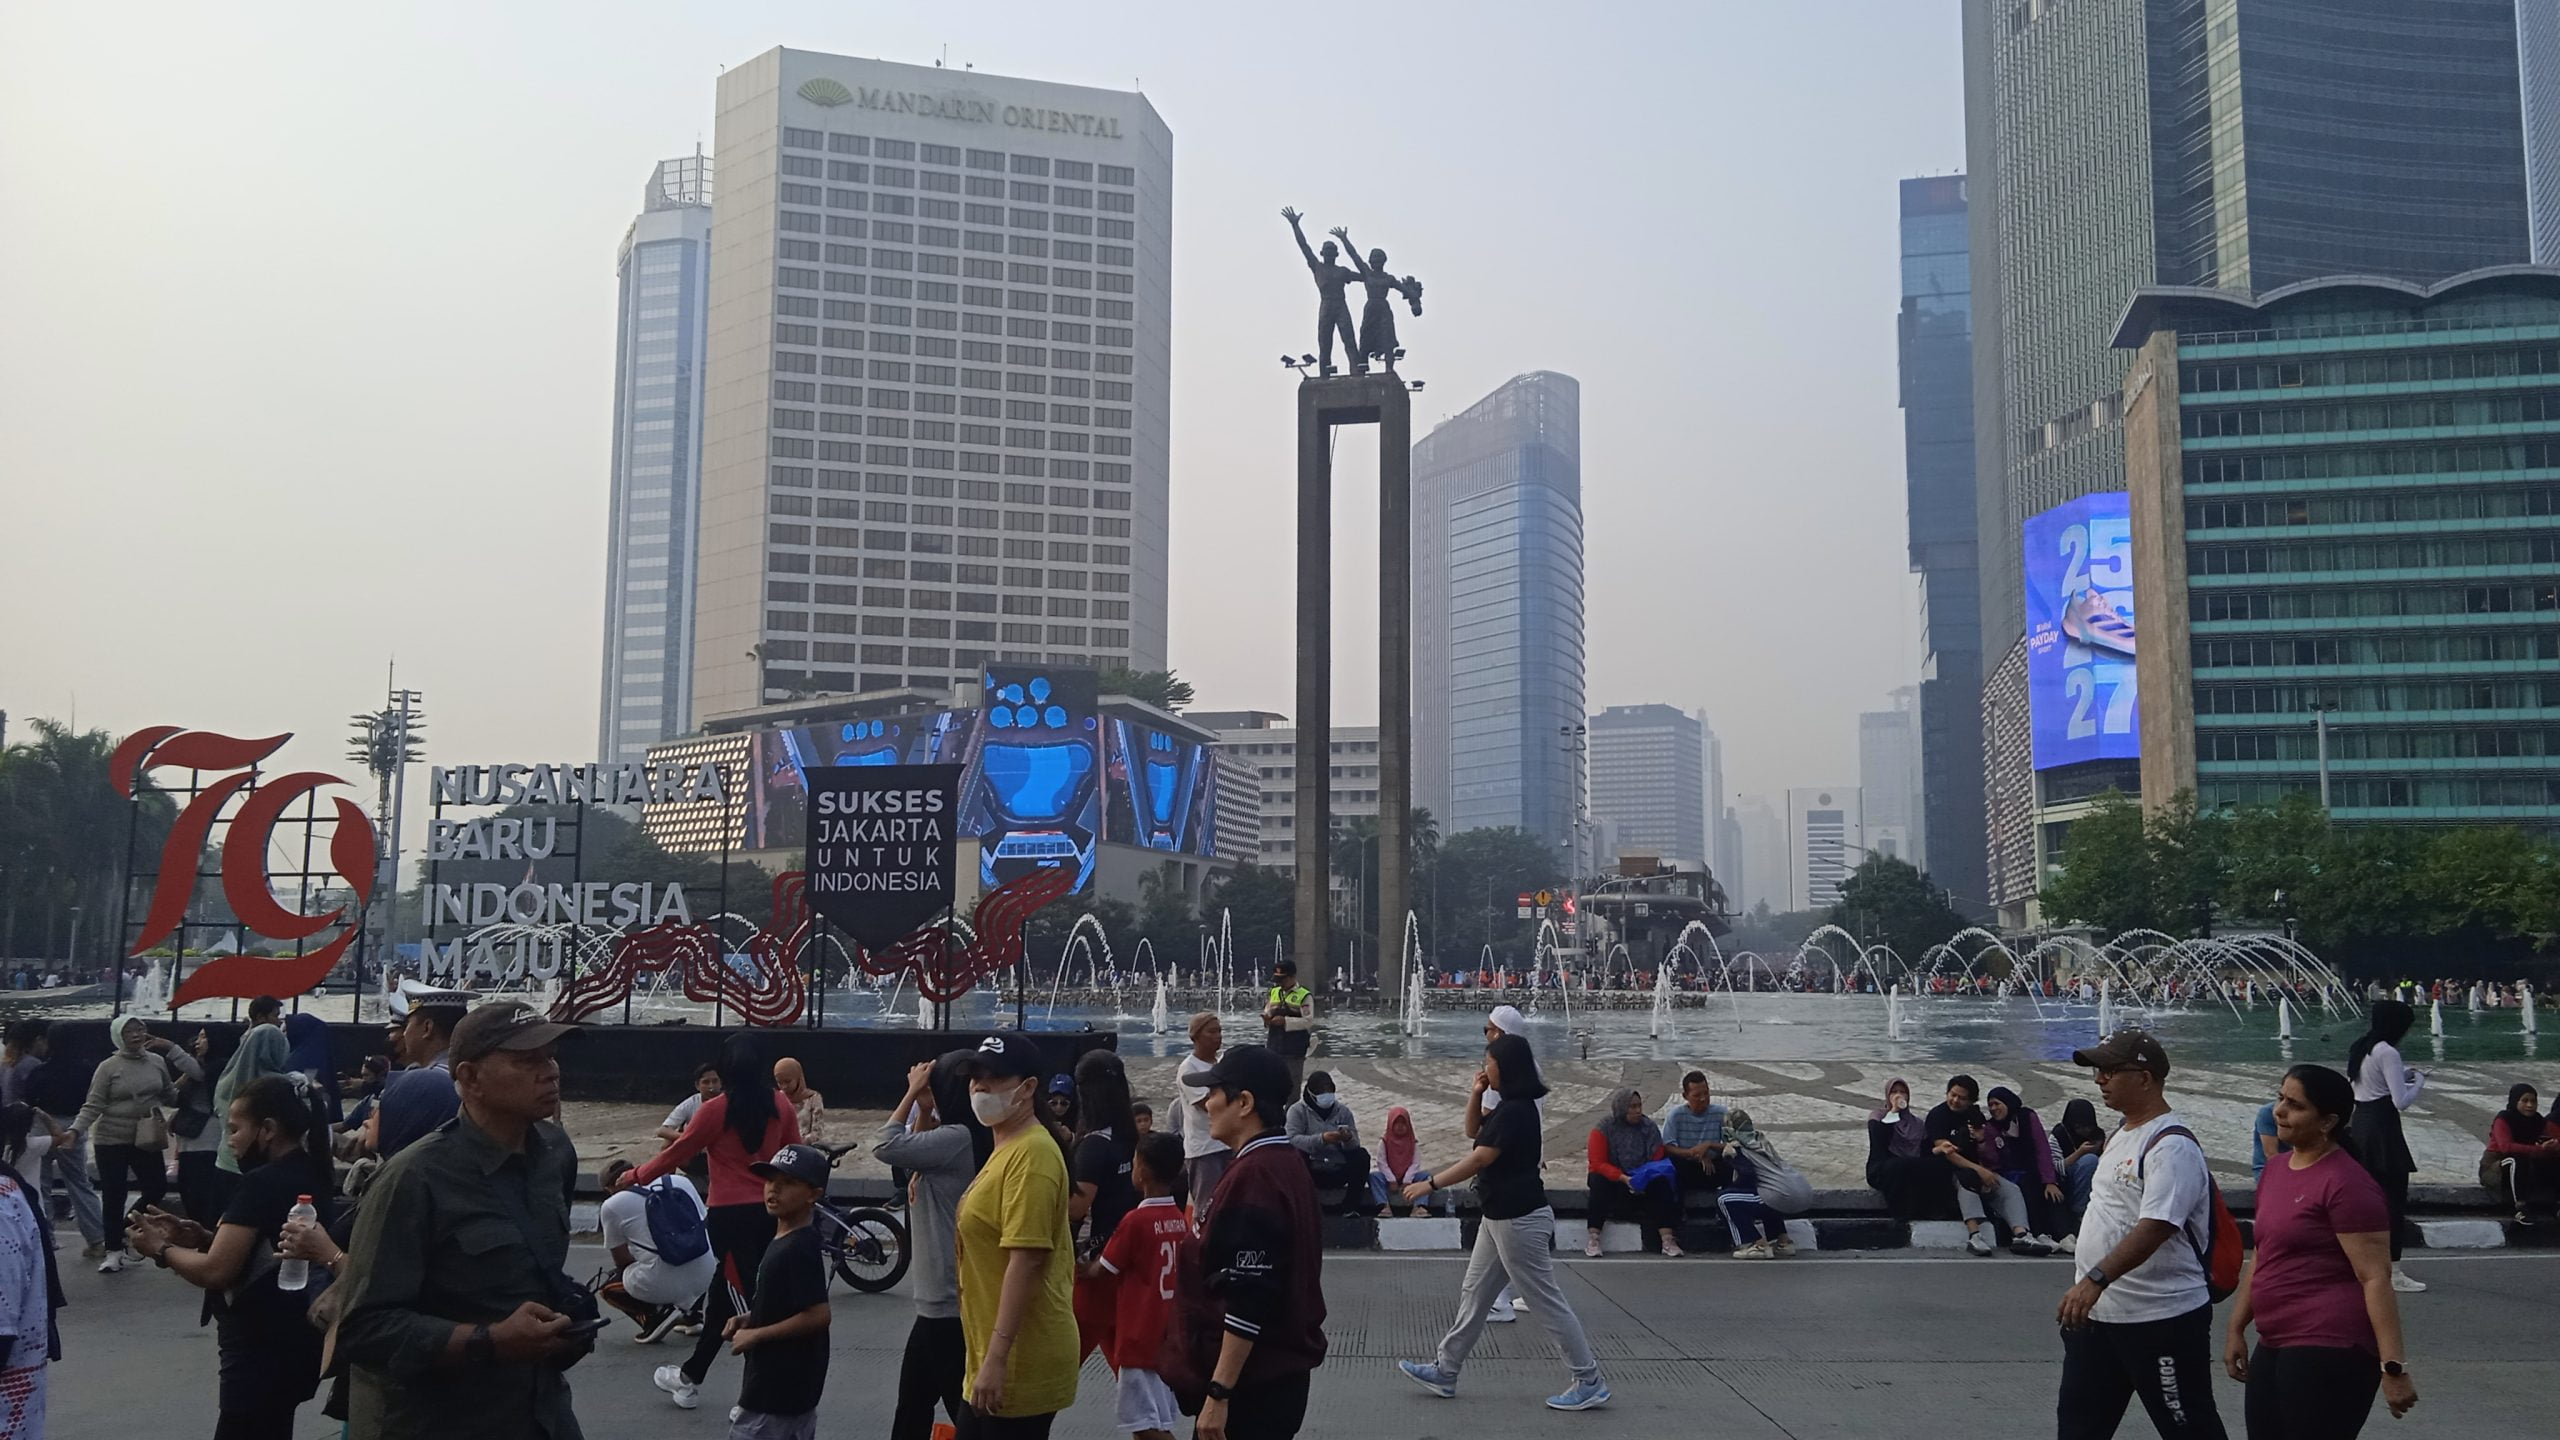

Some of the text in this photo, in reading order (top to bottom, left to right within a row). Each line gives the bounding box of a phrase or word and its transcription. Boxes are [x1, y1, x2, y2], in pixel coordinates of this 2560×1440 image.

[857, 87, 1123, 139] MANDARIN ORIENTAL
[2060, 518, 2133, 598] 25
[2030, 631, 2059, 650] PAYDAY
[2065, 664, 2138, 741] 27
[429, 763, 727, 806] NUSANTARA
[818, 790, 944, 814] SUKSES
[427, 817, 556, 860] BARU
[818, 818, 942, 843] JAKARTA
[818, 847, 940, 867] UNTUK
[815, 871, 941, 891] INDONESIA
[422, 882, 691, 926] INDONESIA
[419, 937, 562, 981] MAJU
